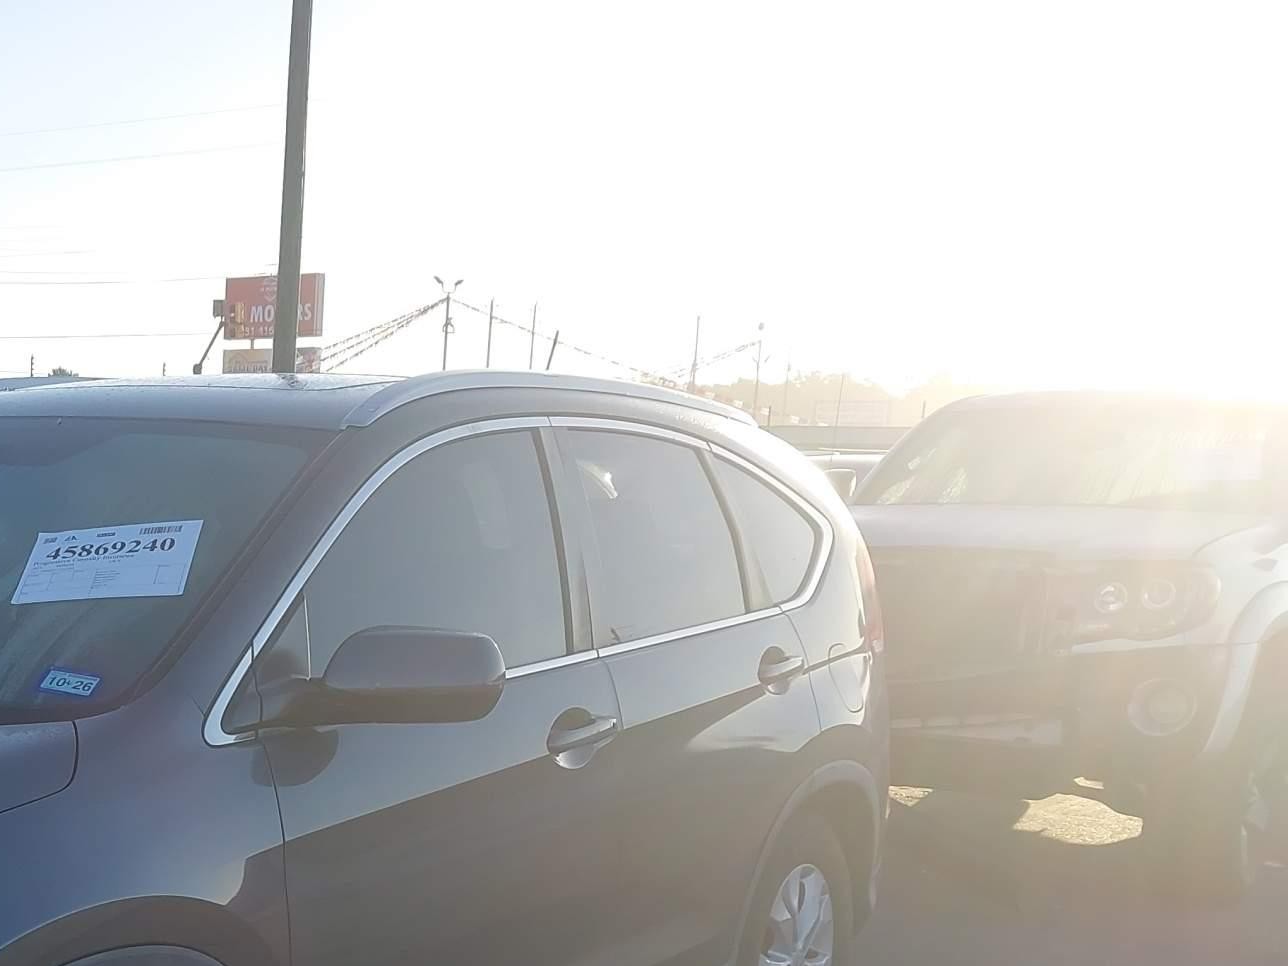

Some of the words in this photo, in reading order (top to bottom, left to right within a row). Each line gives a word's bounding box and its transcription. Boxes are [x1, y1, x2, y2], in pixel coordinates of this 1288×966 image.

[46, 537, 176, 560] 45869240
[49, 676, 67, 687] 10
[72, 680, 94, 692] 26
